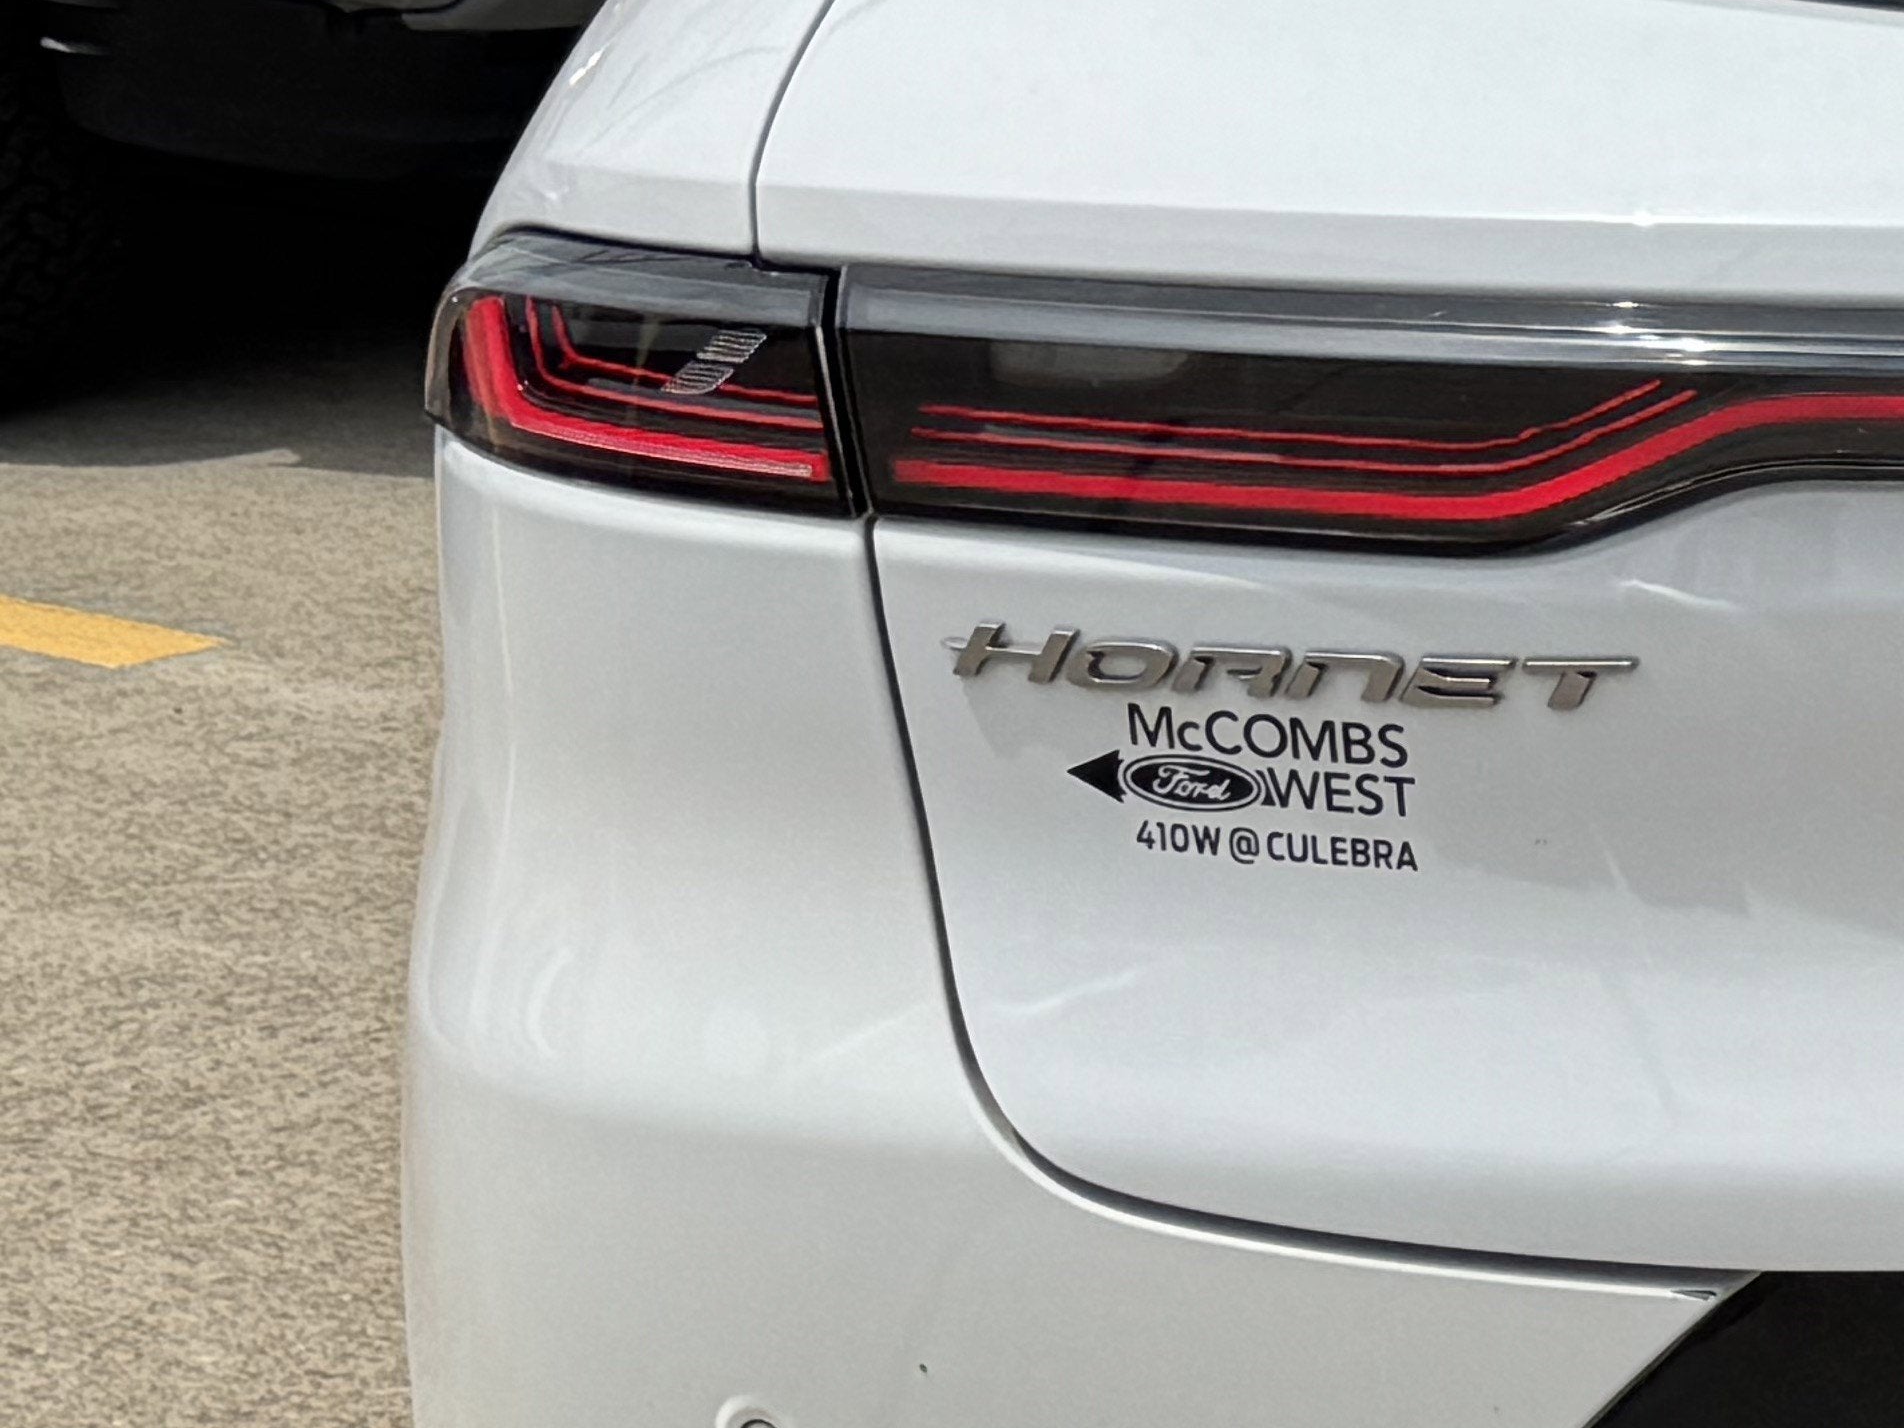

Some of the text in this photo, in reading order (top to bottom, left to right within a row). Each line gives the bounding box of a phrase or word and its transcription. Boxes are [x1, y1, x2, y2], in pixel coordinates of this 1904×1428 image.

[942, 619, 1639, 710] HORNET
[1126, 703, 1410, 769] McCOMBS
[1152, 763, 1417, 819] Ford WEST
